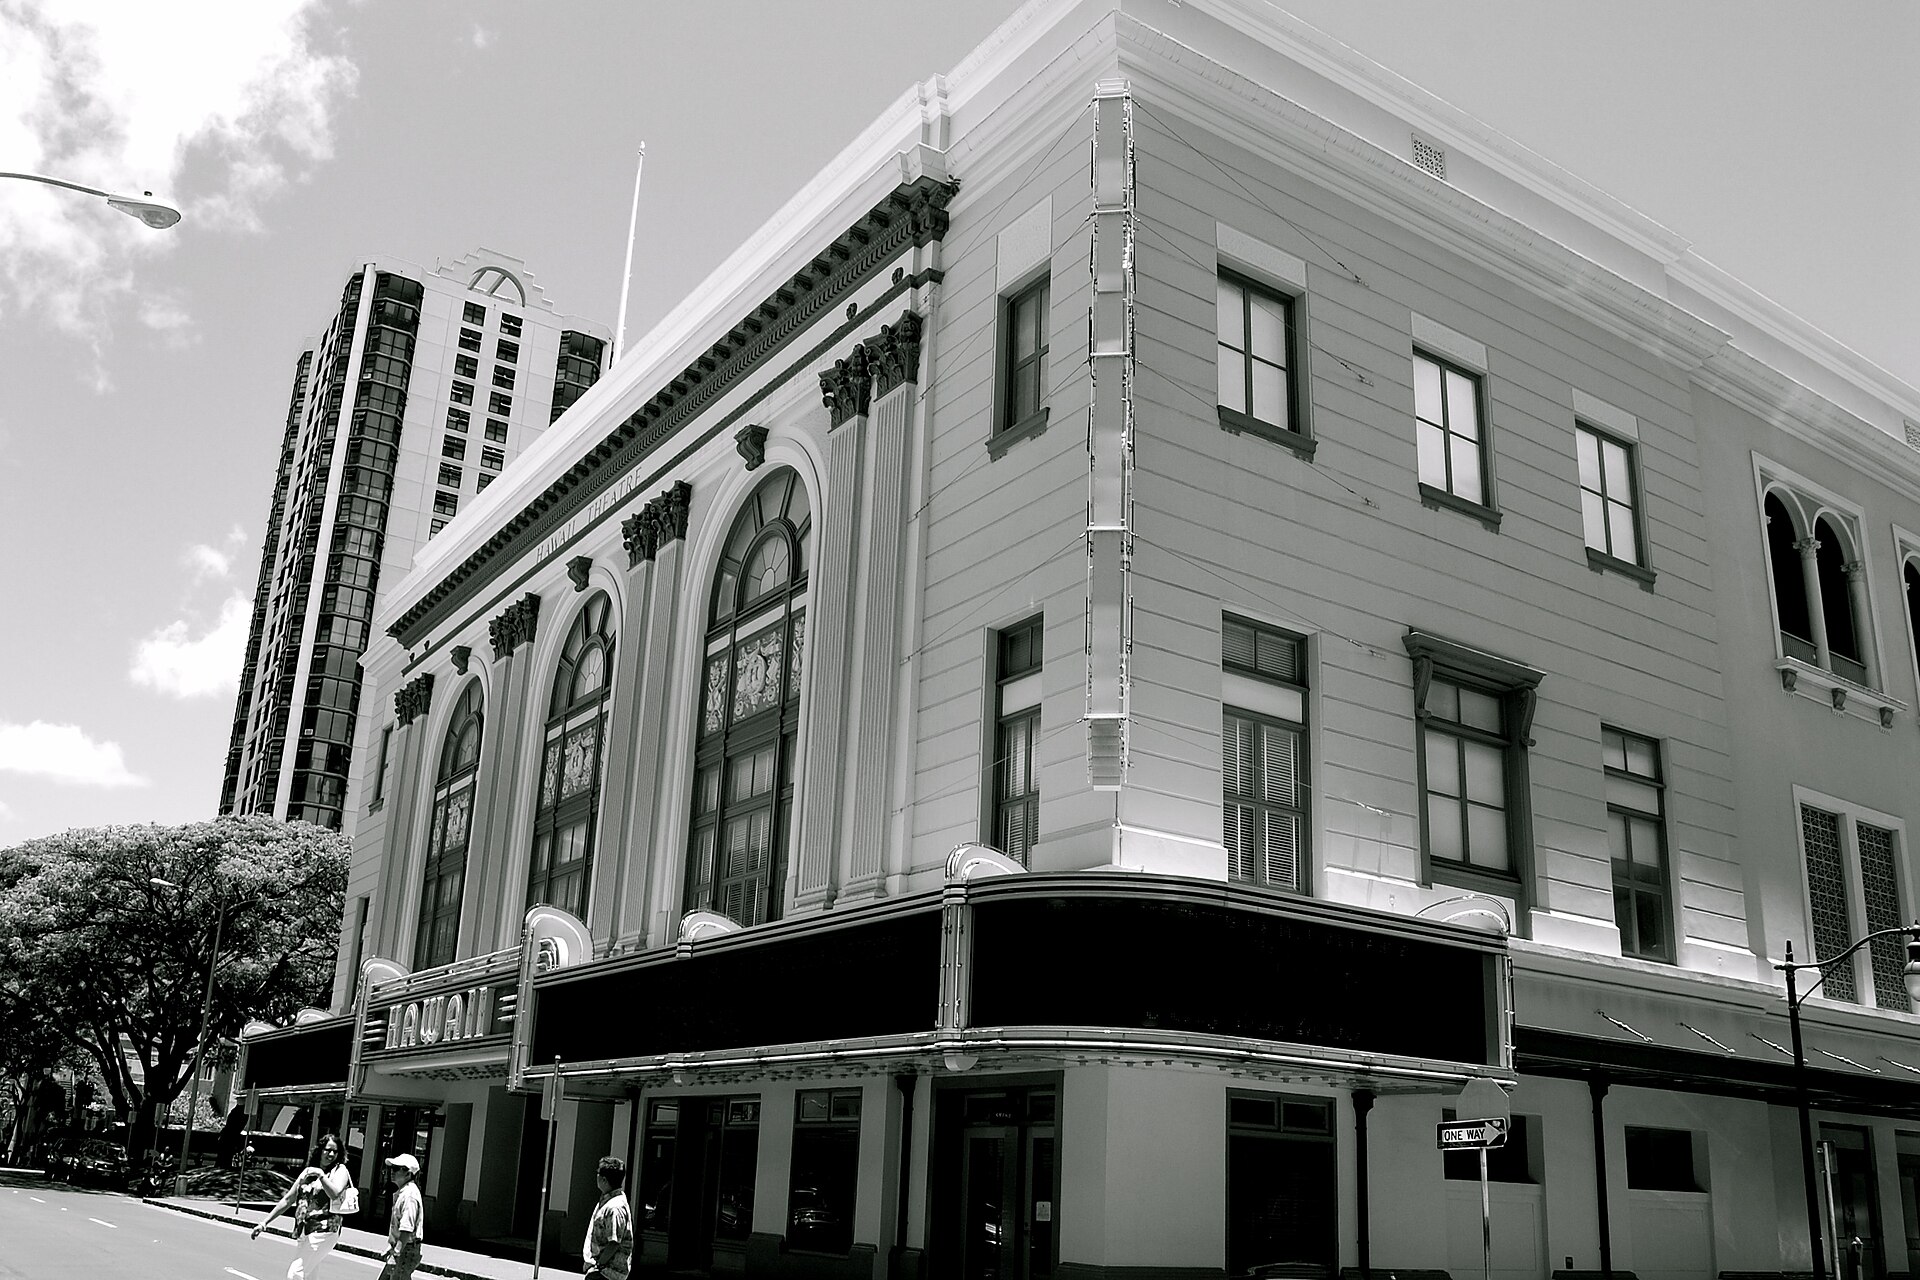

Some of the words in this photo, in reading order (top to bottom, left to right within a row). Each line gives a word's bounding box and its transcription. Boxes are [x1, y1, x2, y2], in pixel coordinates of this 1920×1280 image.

[588, 466, 642, 523] THEATRE
[385, 986, 491, 1050] HAWAII
[1444, 1130, 1463, 1141] ONE
[1466, 1128, 1486, 1140] WAY
